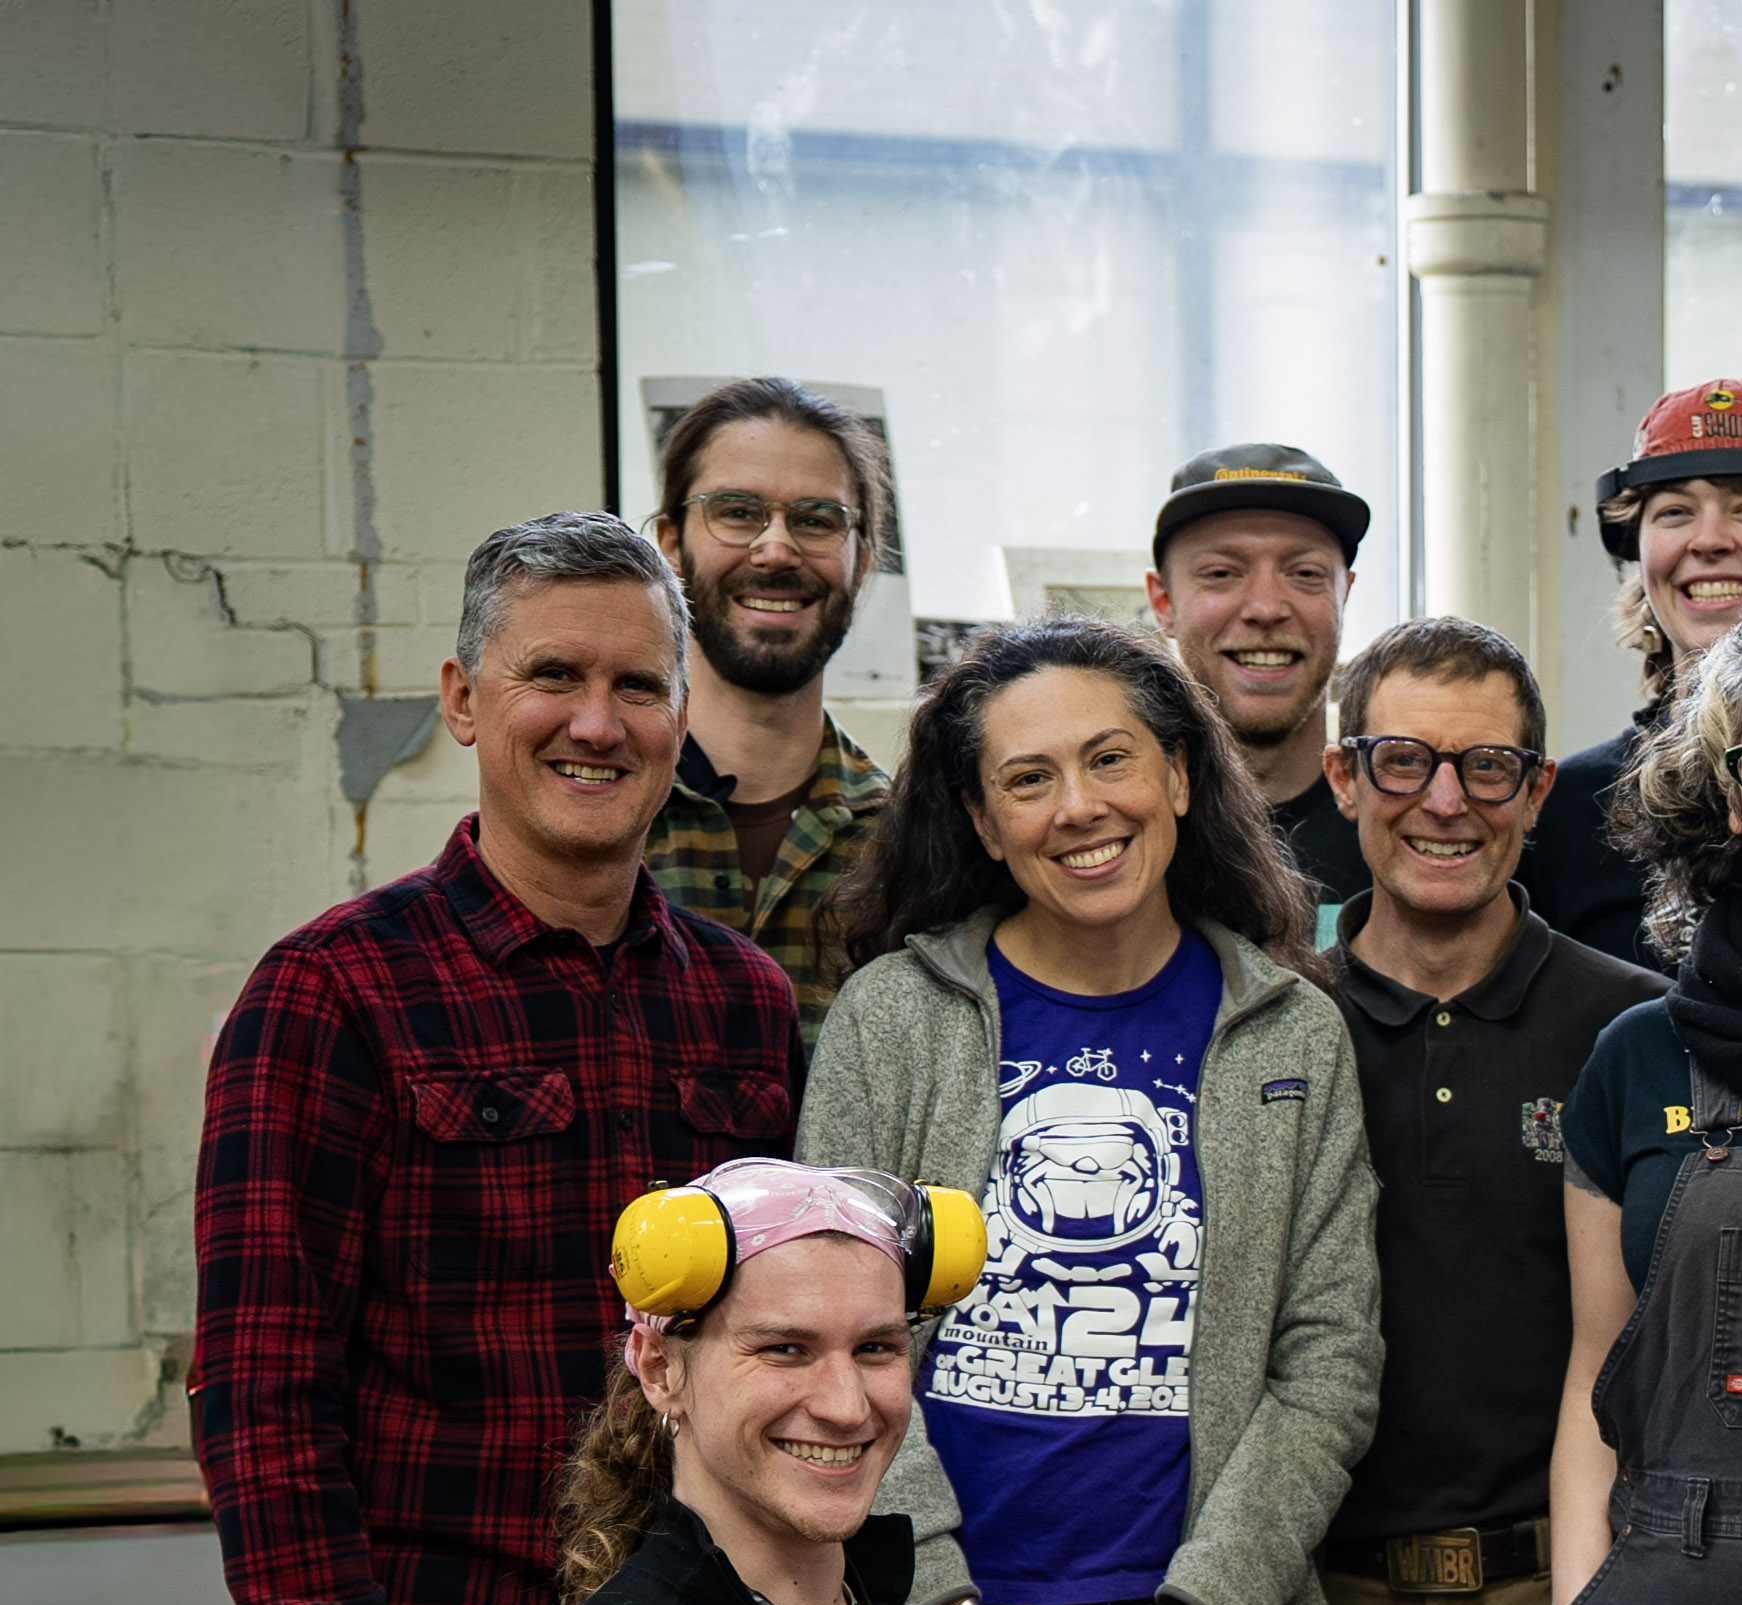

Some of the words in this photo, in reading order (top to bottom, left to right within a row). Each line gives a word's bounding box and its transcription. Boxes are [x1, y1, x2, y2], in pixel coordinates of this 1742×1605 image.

[1534, 1148, 1564, 1163] 2008
[943, 1327, 1048, 1351] mountain
[956, 1345, 1106, 1388] GREAT
[931, 1369, 1057, 1411] AUGUST
